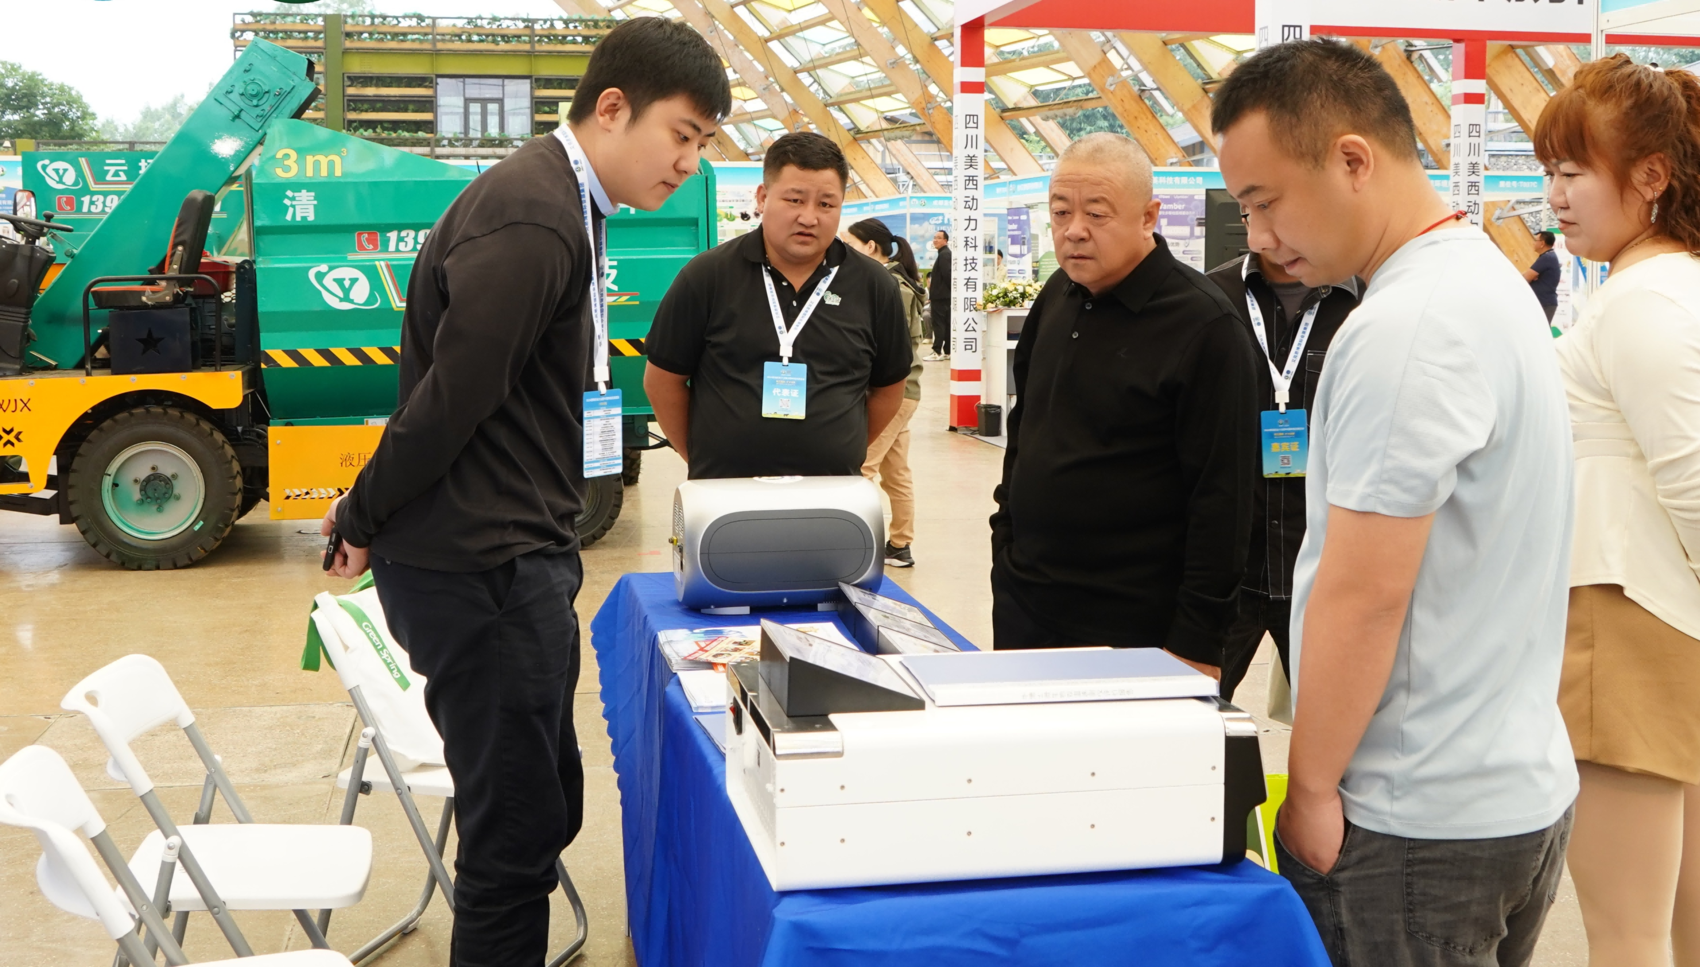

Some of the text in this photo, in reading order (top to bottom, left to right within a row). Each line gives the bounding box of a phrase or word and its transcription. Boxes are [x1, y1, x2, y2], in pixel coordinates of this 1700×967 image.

[80, 195, 125, 213] 139
[283, 190, 317, 221] 清
[963, 114, 979, 354] 四川美西动力科技有限公司
[339, 452, 372, 468] 液压
[362, 621, 401, 679] Green Spring
